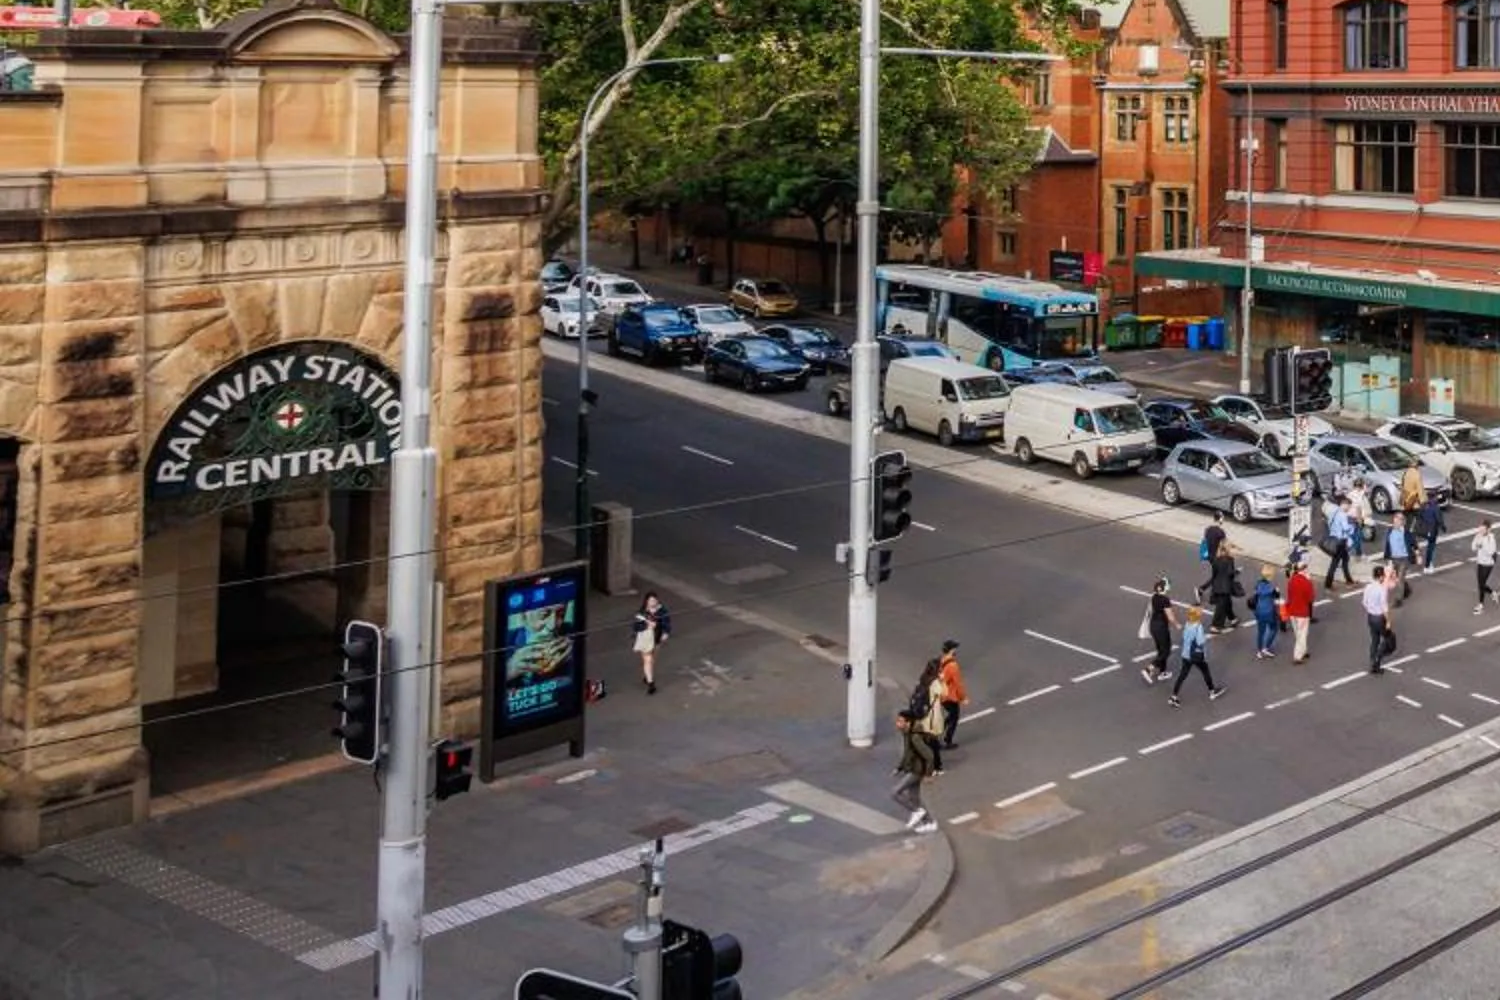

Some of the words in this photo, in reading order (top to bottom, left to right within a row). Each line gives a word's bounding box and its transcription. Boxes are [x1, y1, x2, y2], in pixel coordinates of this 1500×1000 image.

[1344, 95, 1396, 112] SYDNEY
[1400, 95, 1465, 113] CENTRAL
[1469, 96, 1500, 113] YHA
[156, 354, 296, 483] RAILWAY
[195, 440, 385, 491] CENTRAL
